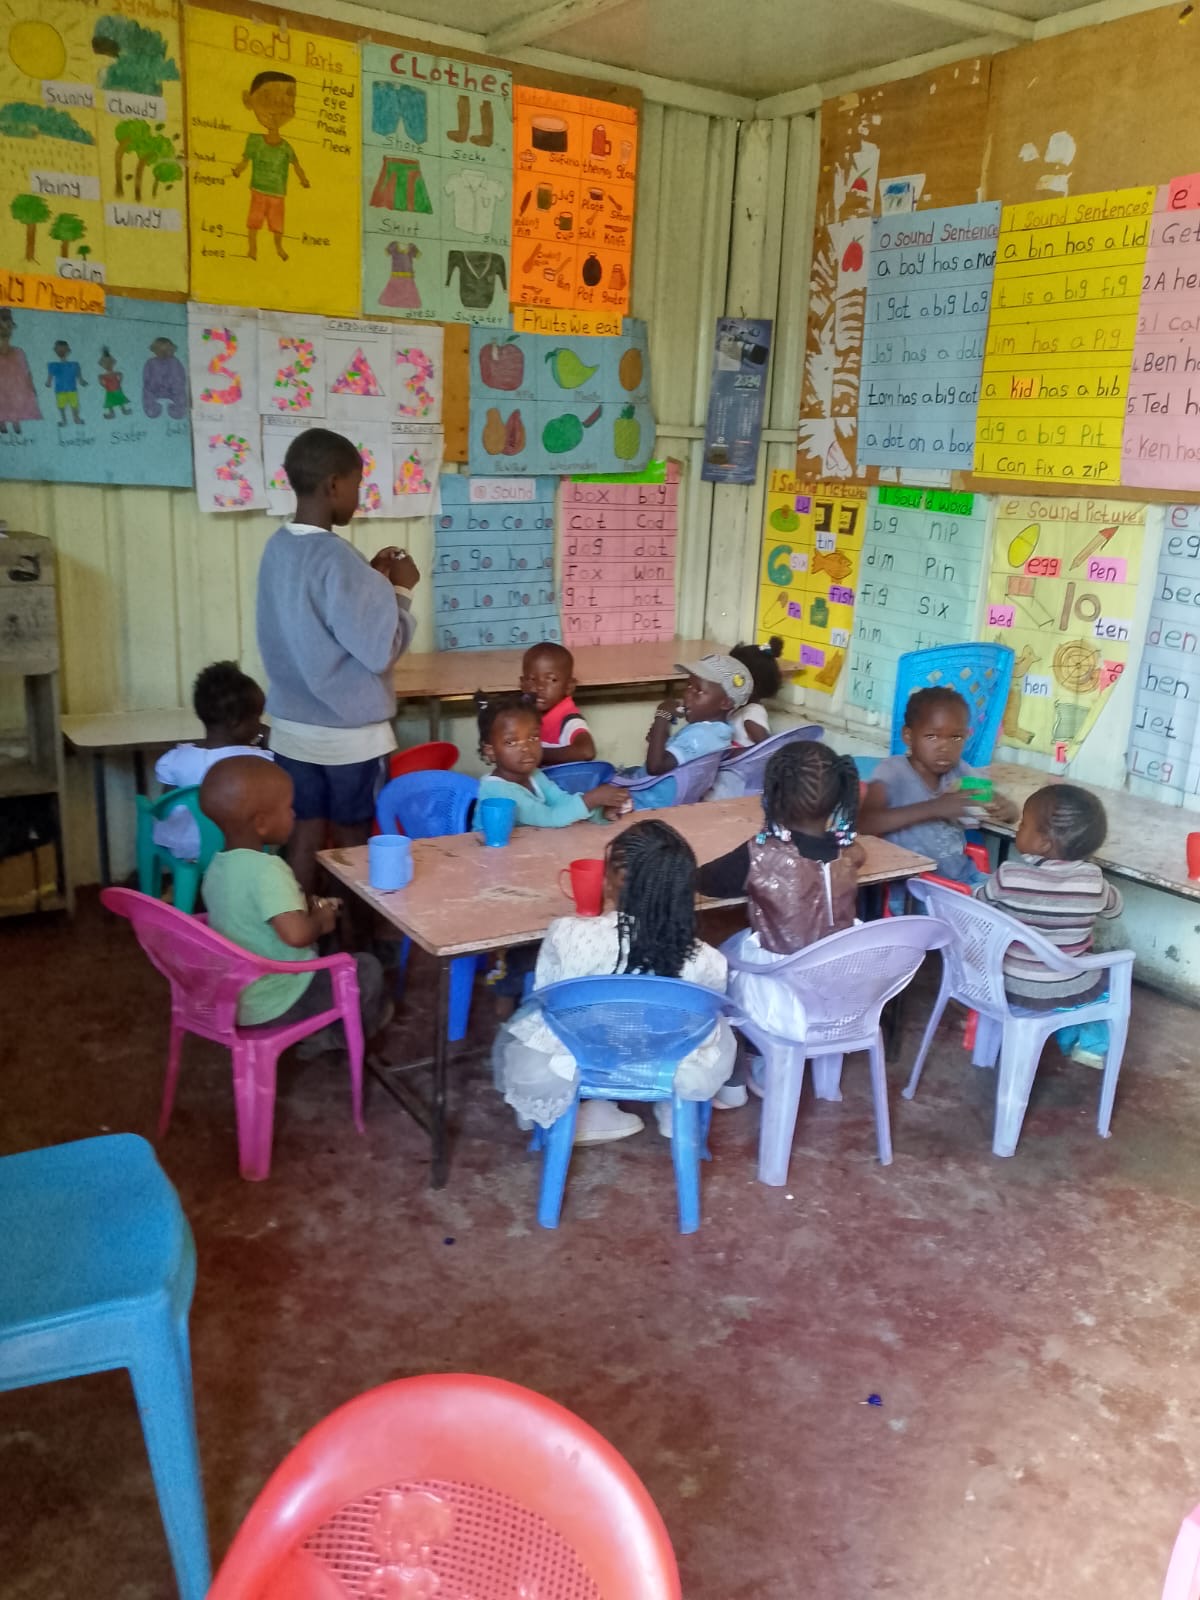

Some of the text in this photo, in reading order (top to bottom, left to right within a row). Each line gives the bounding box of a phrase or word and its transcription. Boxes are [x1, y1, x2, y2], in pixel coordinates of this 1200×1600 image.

[233, 25, 344, 73] Body Parts
[46, 87, 94, 108] Sunny
[321, 80, 355, 98] Head
[108, 98, 157, 119] Cloudy
[323, 97, 348, 110] eye
[1004, 243, 1018, 260] a
[1028, 234, 1055, 259] bin
[1065, 231, 1096, 255] has
[1104, 237, 1116, 250] a
[59, 262, 103, 283] Calm
[877, 260, 891, 277] a
[899, 252, 926, 276] boy
[933, 246, 959, 272] has
[1065, 275, 1089, 301] big
[1153, 271, 1166, 291] A
[887, 296, 912, 321] got
[933, 293, 957, 317] big
[595, 319, 621, 336] eat
[902, 337, 927, 362] has
[937, 348, 950, 360] a
[1032, 329, 1060, 353] has
[1070, 337, 1084, 348] a
[1143, 352, 1177, 372] Ben
[898, 383, 918, 405] has
[922, 393, 934, 404] a
[935, 381, 957, 405] big
[985, 383, 997, 397] a
[1038, 375, 1069, 398] has
[1077, 384, 1090, 396] a
[1096, 375, 1121, 397] bib
[1142, 392, 1171, 414] Ted
[866, 433, 878, 447] a
[882, 423, 905, 449] dot
[933, 438, 945, 452] a
[948, 427, 975, 454] box
[980, 418, 1005, 442] dig
[1017, 428, 1028, 441] a
[1038, 423, 1067, 446] big
[1062, 463, 1074, 477] a
[1006, 501, 1020, 515] e
[873, 511, 899, 534] big
[866, 549, 895, 571] dim
[1027, 558, 1059, 576] egg
[989, 609, 1014, 628] bed
[1095, 618, 1129, 640] ten
[1148, 618, 1198, 653] den
[1024, 675, 1049, 695] hen
[1145, 662, 1190, 700] hen
